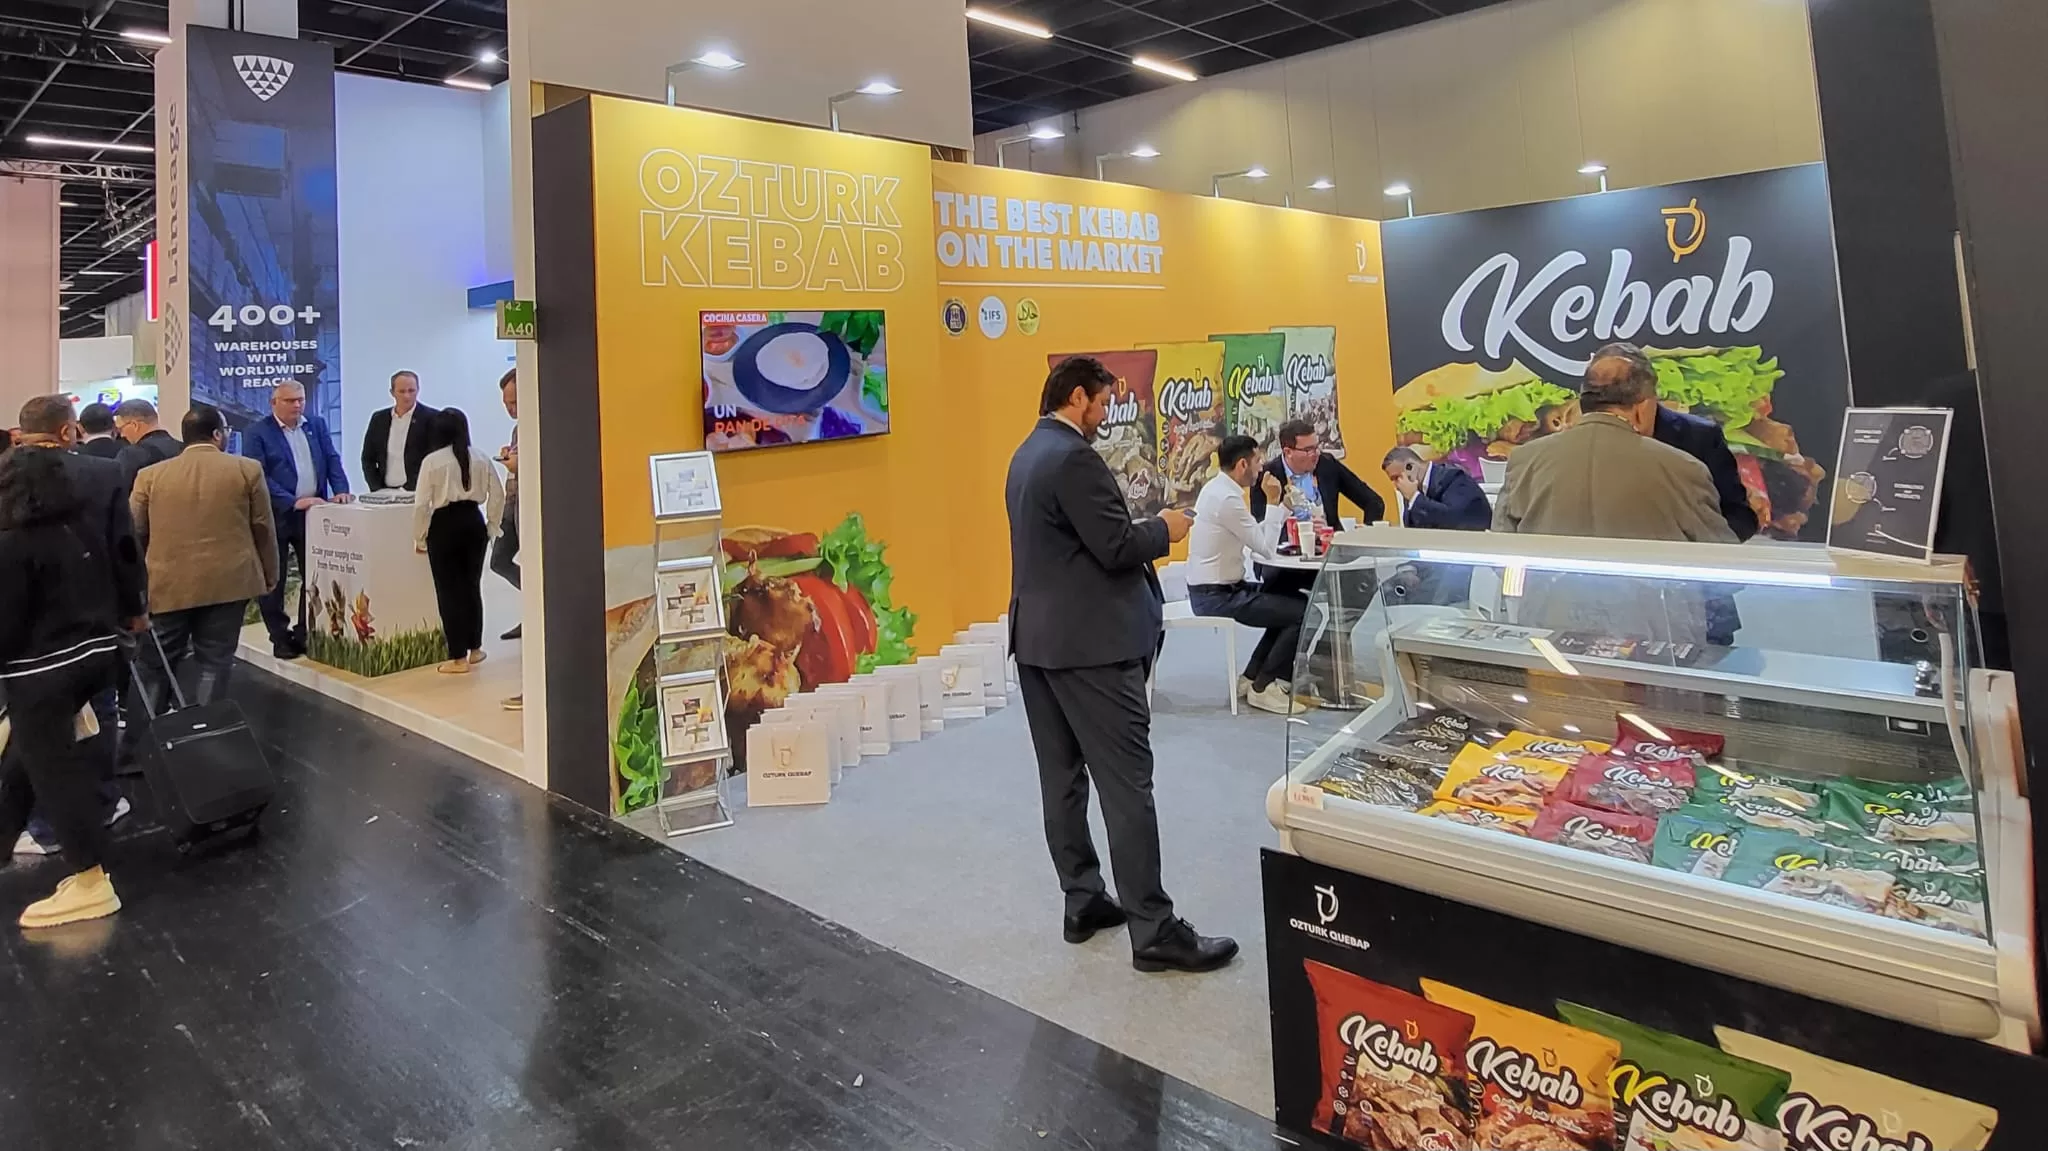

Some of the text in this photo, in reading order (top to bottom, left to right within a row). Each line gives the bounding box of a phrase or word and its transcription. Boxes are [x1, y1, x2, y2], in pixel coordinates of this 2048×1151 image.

[168, 102, 180, 287] Lineage
[640, 148, 902, 227] OZTURK
[933, 191, 1161, 242] THE BEST KEBAB
[640, 210, 905, 291] KEBAB
[937, 231, 1164, 274] ON THE MARKET
[208, 304, 321, 333] 400+
[988, 309, 1001, 321] IFS
[1441, 235, 1774, 377] Kebab
[214, 340, 318, 352] WAREHOUSES
[505, 322, 534, 336] A40
[219, 364, 314, 377] WORLDWIDE
[247, 353, 287, 363] WITH
[1286, 354, 1326, 390] Kebab
[1160, 379, 1213, 422] Kebab
[1228, 365, 1274, 404] Kebab
[714, 404, 737, 418] UN
[1289, 917, 1329, 938] OZTURK
[1329, 930, 1371, 950] QUEBAP
[1340, 1015, 1438, 1074] Kebab
[1466, 1041, 1580, 1105] Kebab
[1608, 1064, 1741, 1138] Kebab
